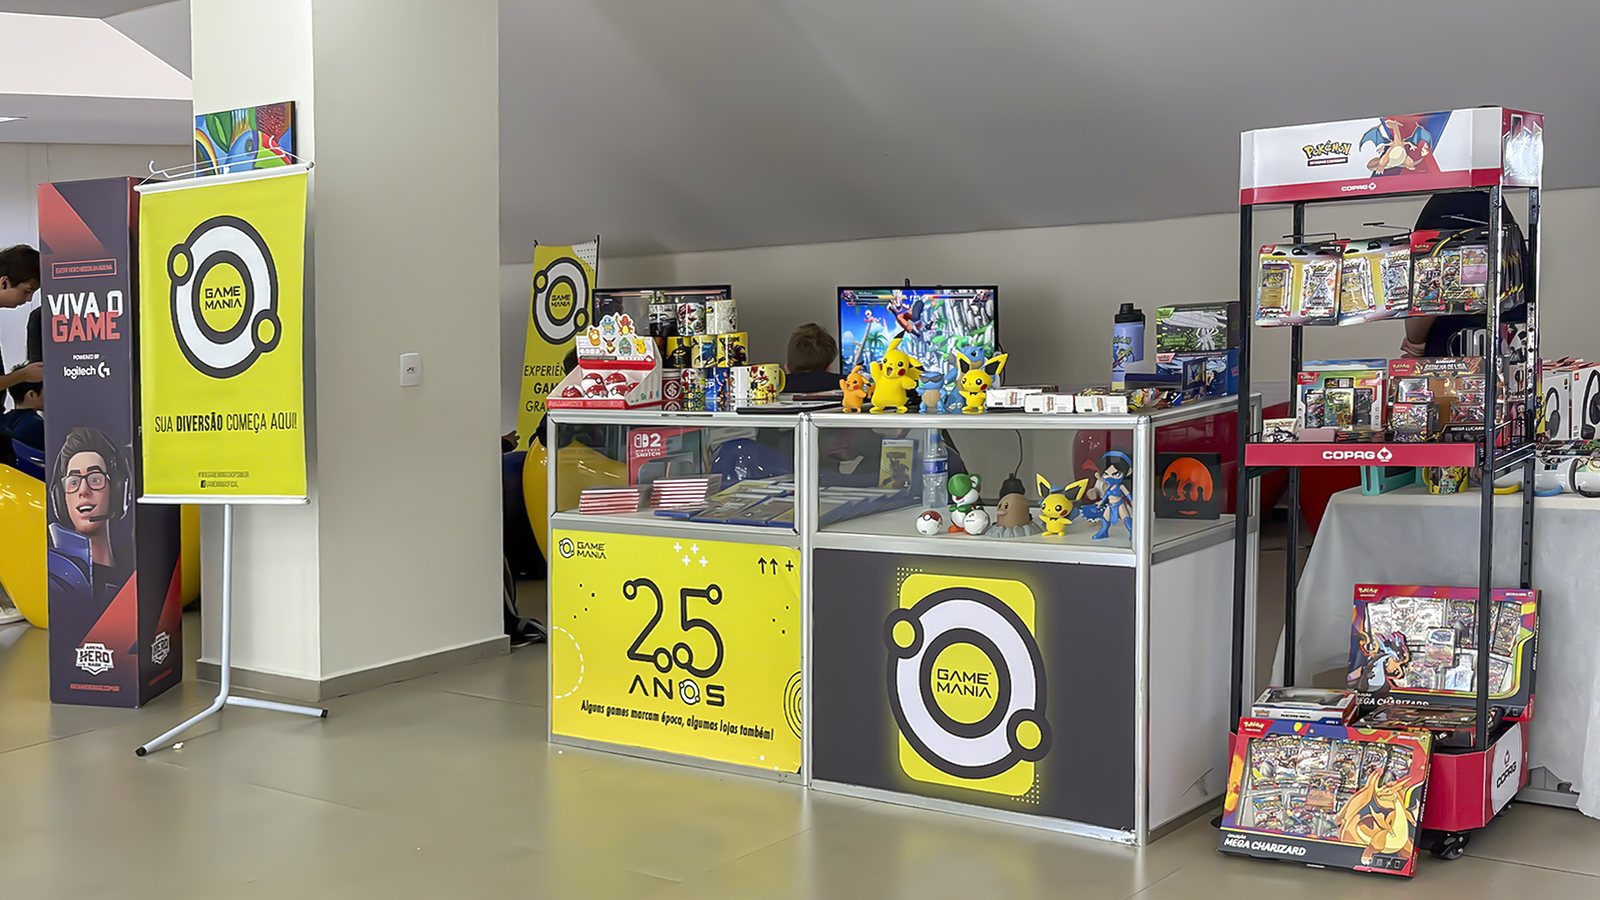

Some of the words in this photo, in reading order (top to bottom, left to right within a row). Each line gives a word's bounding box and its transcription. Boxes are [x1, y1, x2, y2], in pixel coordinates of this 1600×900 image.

[205, 286, 241, 299] GAME
[47, 291, 100, 320] VIVA
[107, 290, 123, 317] O
[205, 298, 242, 310] MANIA
[51, 312, 121, 342] GAME
[64, 364, 96, 380] logitech
[155, 416, 173, 432] SUA
[176, 412, 223, 432] DIVERSÃO
[226, 413, 267, 433] COMEÇA
[270, 412, 297, 430] AQUI!
[650, 433, 661, 447] 2
[1322, 450, 1376, 460] COPAG
[577, 541, 605, 551] GAME
[577, 550, 606, 560] MANIA
[623, 577, 724, 678] 25
[79, 650, 110, 663] HERO
[937, 669, 989, 685] GAME
[628, 674, 725, 707] ANOS
[937, 681, 992, 699] MANIA
[581, 700, 605, 715] Alguns
[606, 705, 629, 717] games
[630, 709, 659, 722] marcam
[661, 712, 685, 728] época,
[686, 715, 718, 731] algumas
[720, 719, 738, 736] lojas
[739, 724, 774, 741] também!
[1224, 837, 1251, 849] MEGA
[1251, 840, 1306, 856] CHARIZARD
